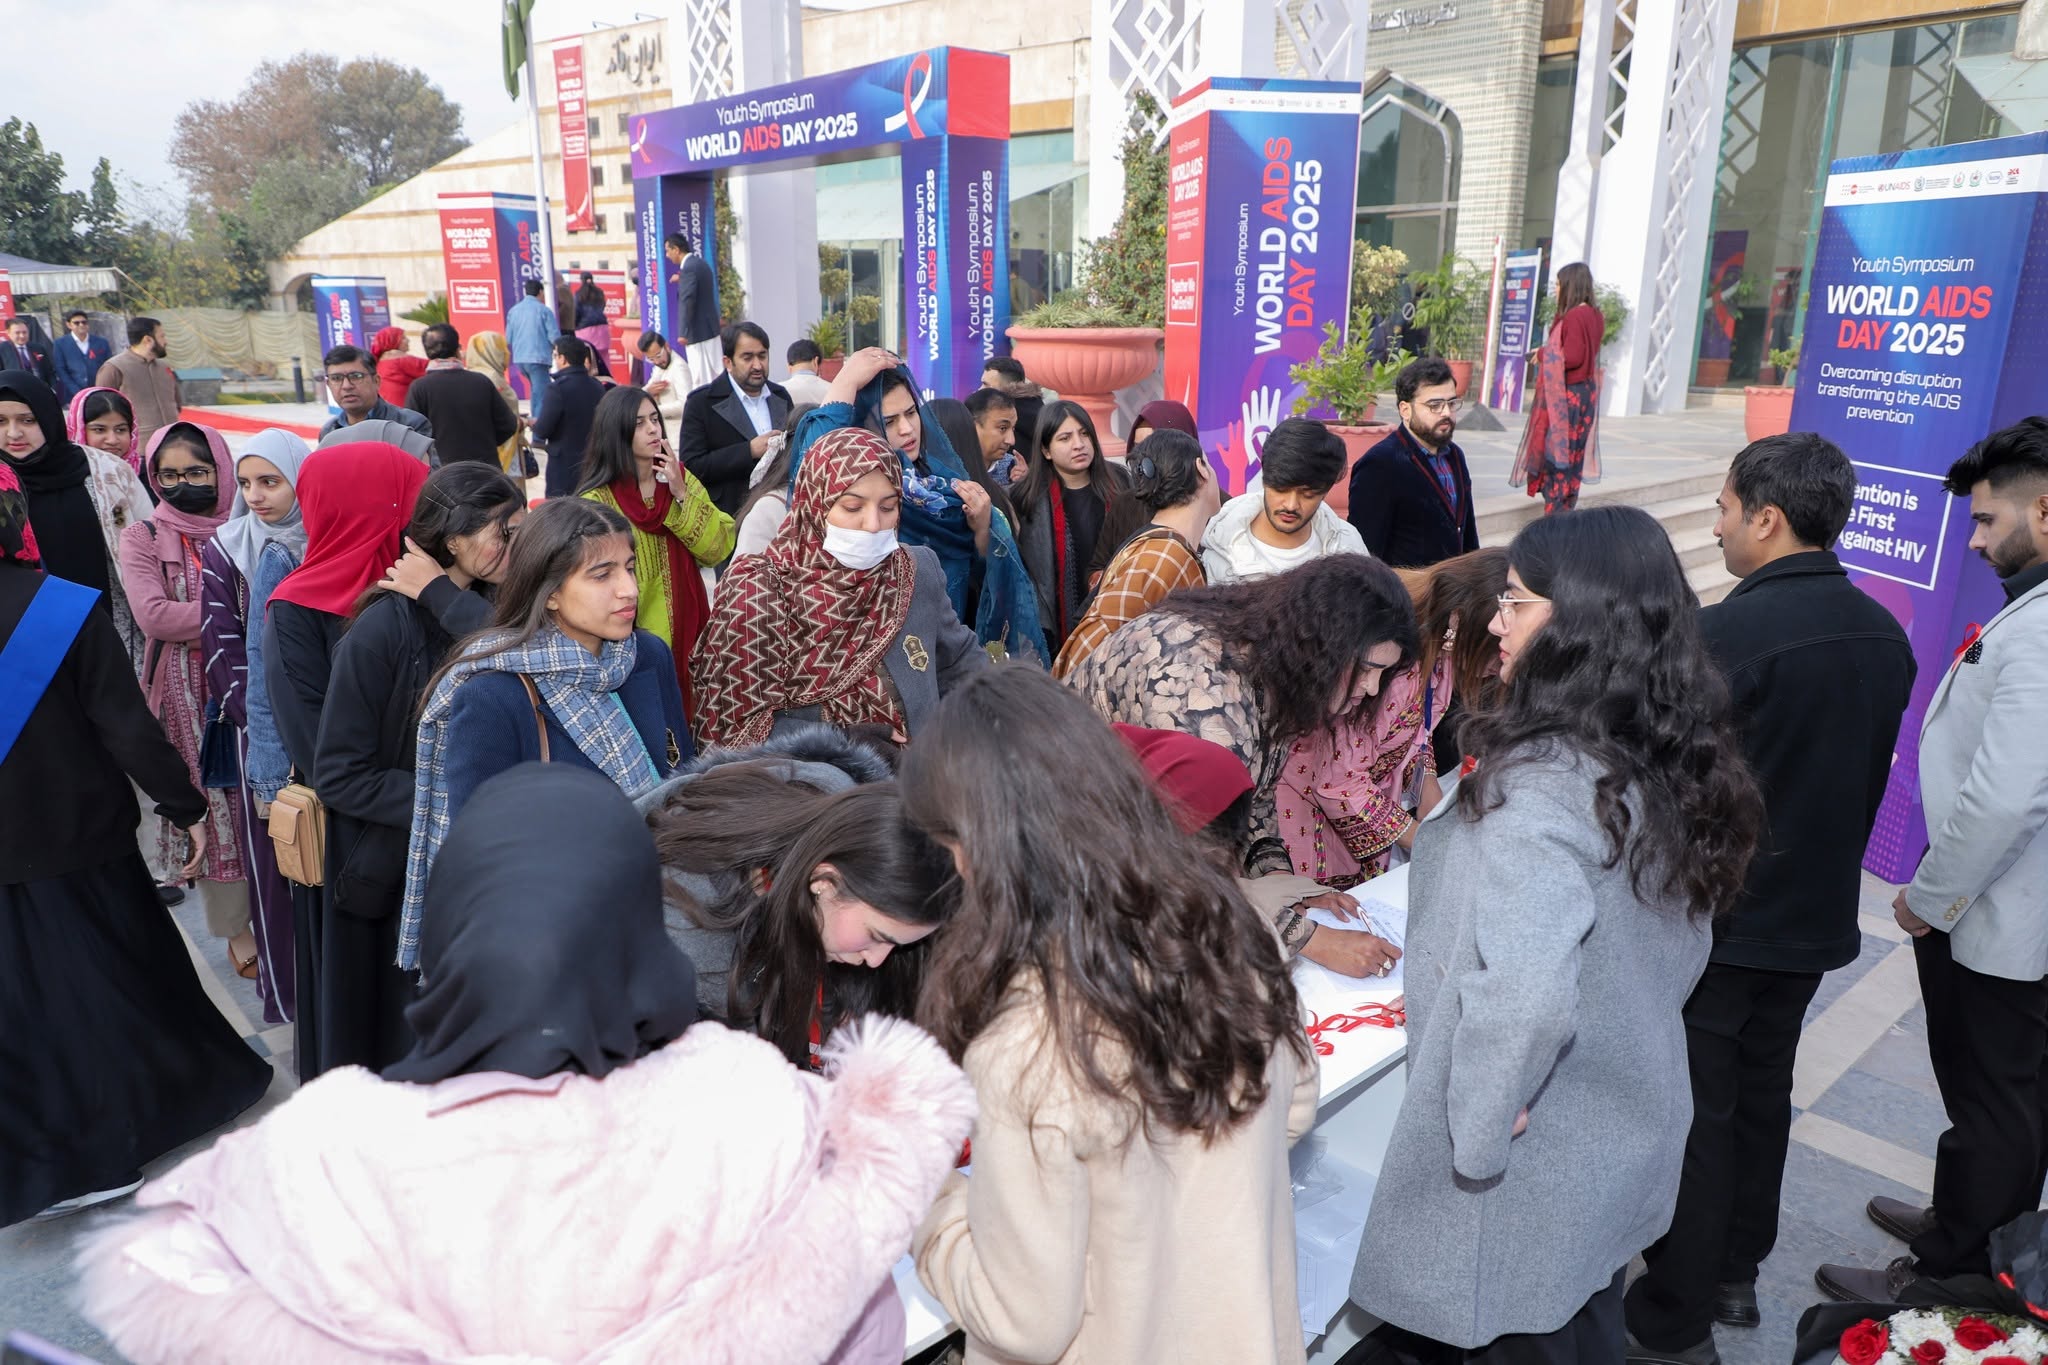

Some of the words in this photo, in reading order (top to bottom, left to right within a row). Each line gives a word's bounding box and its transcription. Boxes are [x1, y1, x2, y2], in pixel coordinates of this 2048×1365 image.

[716, 106, 748, 126] Youth
[749, 93, 815, 123] Symposium
[686, 130, 741, 161] WORLD
[742, 122, 781, 152] AIDS
[783, 120, 813, 147] DAY
[815, 112, 858, 142] 2025
[926, 169, 935, 212] 2025
[1172, 162, 1190, 184] WORLD
[1174, 184, 1185, 203] DAY
[1185, 178, 1199, 201] 2025
[1261, 136, 1292, 223] AIDS
[982, 170, 993, 214] 2025
[1290, 159, 1322, 253] 2025
[445, 228, 471, 239] WORLD
[472, 228, 491, 238] AIDS
[691, 202, 702, 234] 2025
[915, 183, 928, 284] Symposium
[927, 213, 937, 247] DAY
[967, 182, 981, 283] Symposium
[982, 219, 993, 247] DAY
[452, 239, 467, 249] DAY
[467, 238, 488, 249] 2025
[517, 221, 531, 262] AIDS
[530, 232, 544, 278] 2025
[1235, 203, 1249, 276] Symposium
[928, 249, 937, 292] AIDS
[982, 249, 994, 292] AIDS
[1852, 257, 1890, 273] Youth
[1892, 255, 1974, 276] Symposium
[1233, 278, 1245, 316] Youth
[1254, 227, 1287, 354] WORLD
[1286, 258, 1316, 327] DAY
[1827, 285, 1919, 317] WORLD
[1920, 285, 1993, 319] AIDS
[603, 306, 621, 314] 025
[653, 295, 661, 334] ORLD
[918, 287, 928, 339] Youth
[928, 295, 939, 360] WORLD
[968, 287, 980, 339] Youth
[983, 295, 995, 360] WORLD
[333, 320, 345, 347] ORLD
[344, 330, 354, 347] AY
[1837, 319, 1891, 350] DAY
[1889, 321, 1966, 356] 2025
[1820, 363, 1893, 386] Overcoming
[1894, 369, 1962, 390] disruption
[1817, 382, 1896, 406] transforming
[1897, 390, 1920, 406] the
[1921, 392, 1961, 411] AIDS
[1846, 405, 1914, 425] prevention
[1854, 483, 1901, 508] ention
[1903, 489, 1919, 511] is
[1857, 505, 1896, 532] First
[1894, 538, 1927, 563] HIV
